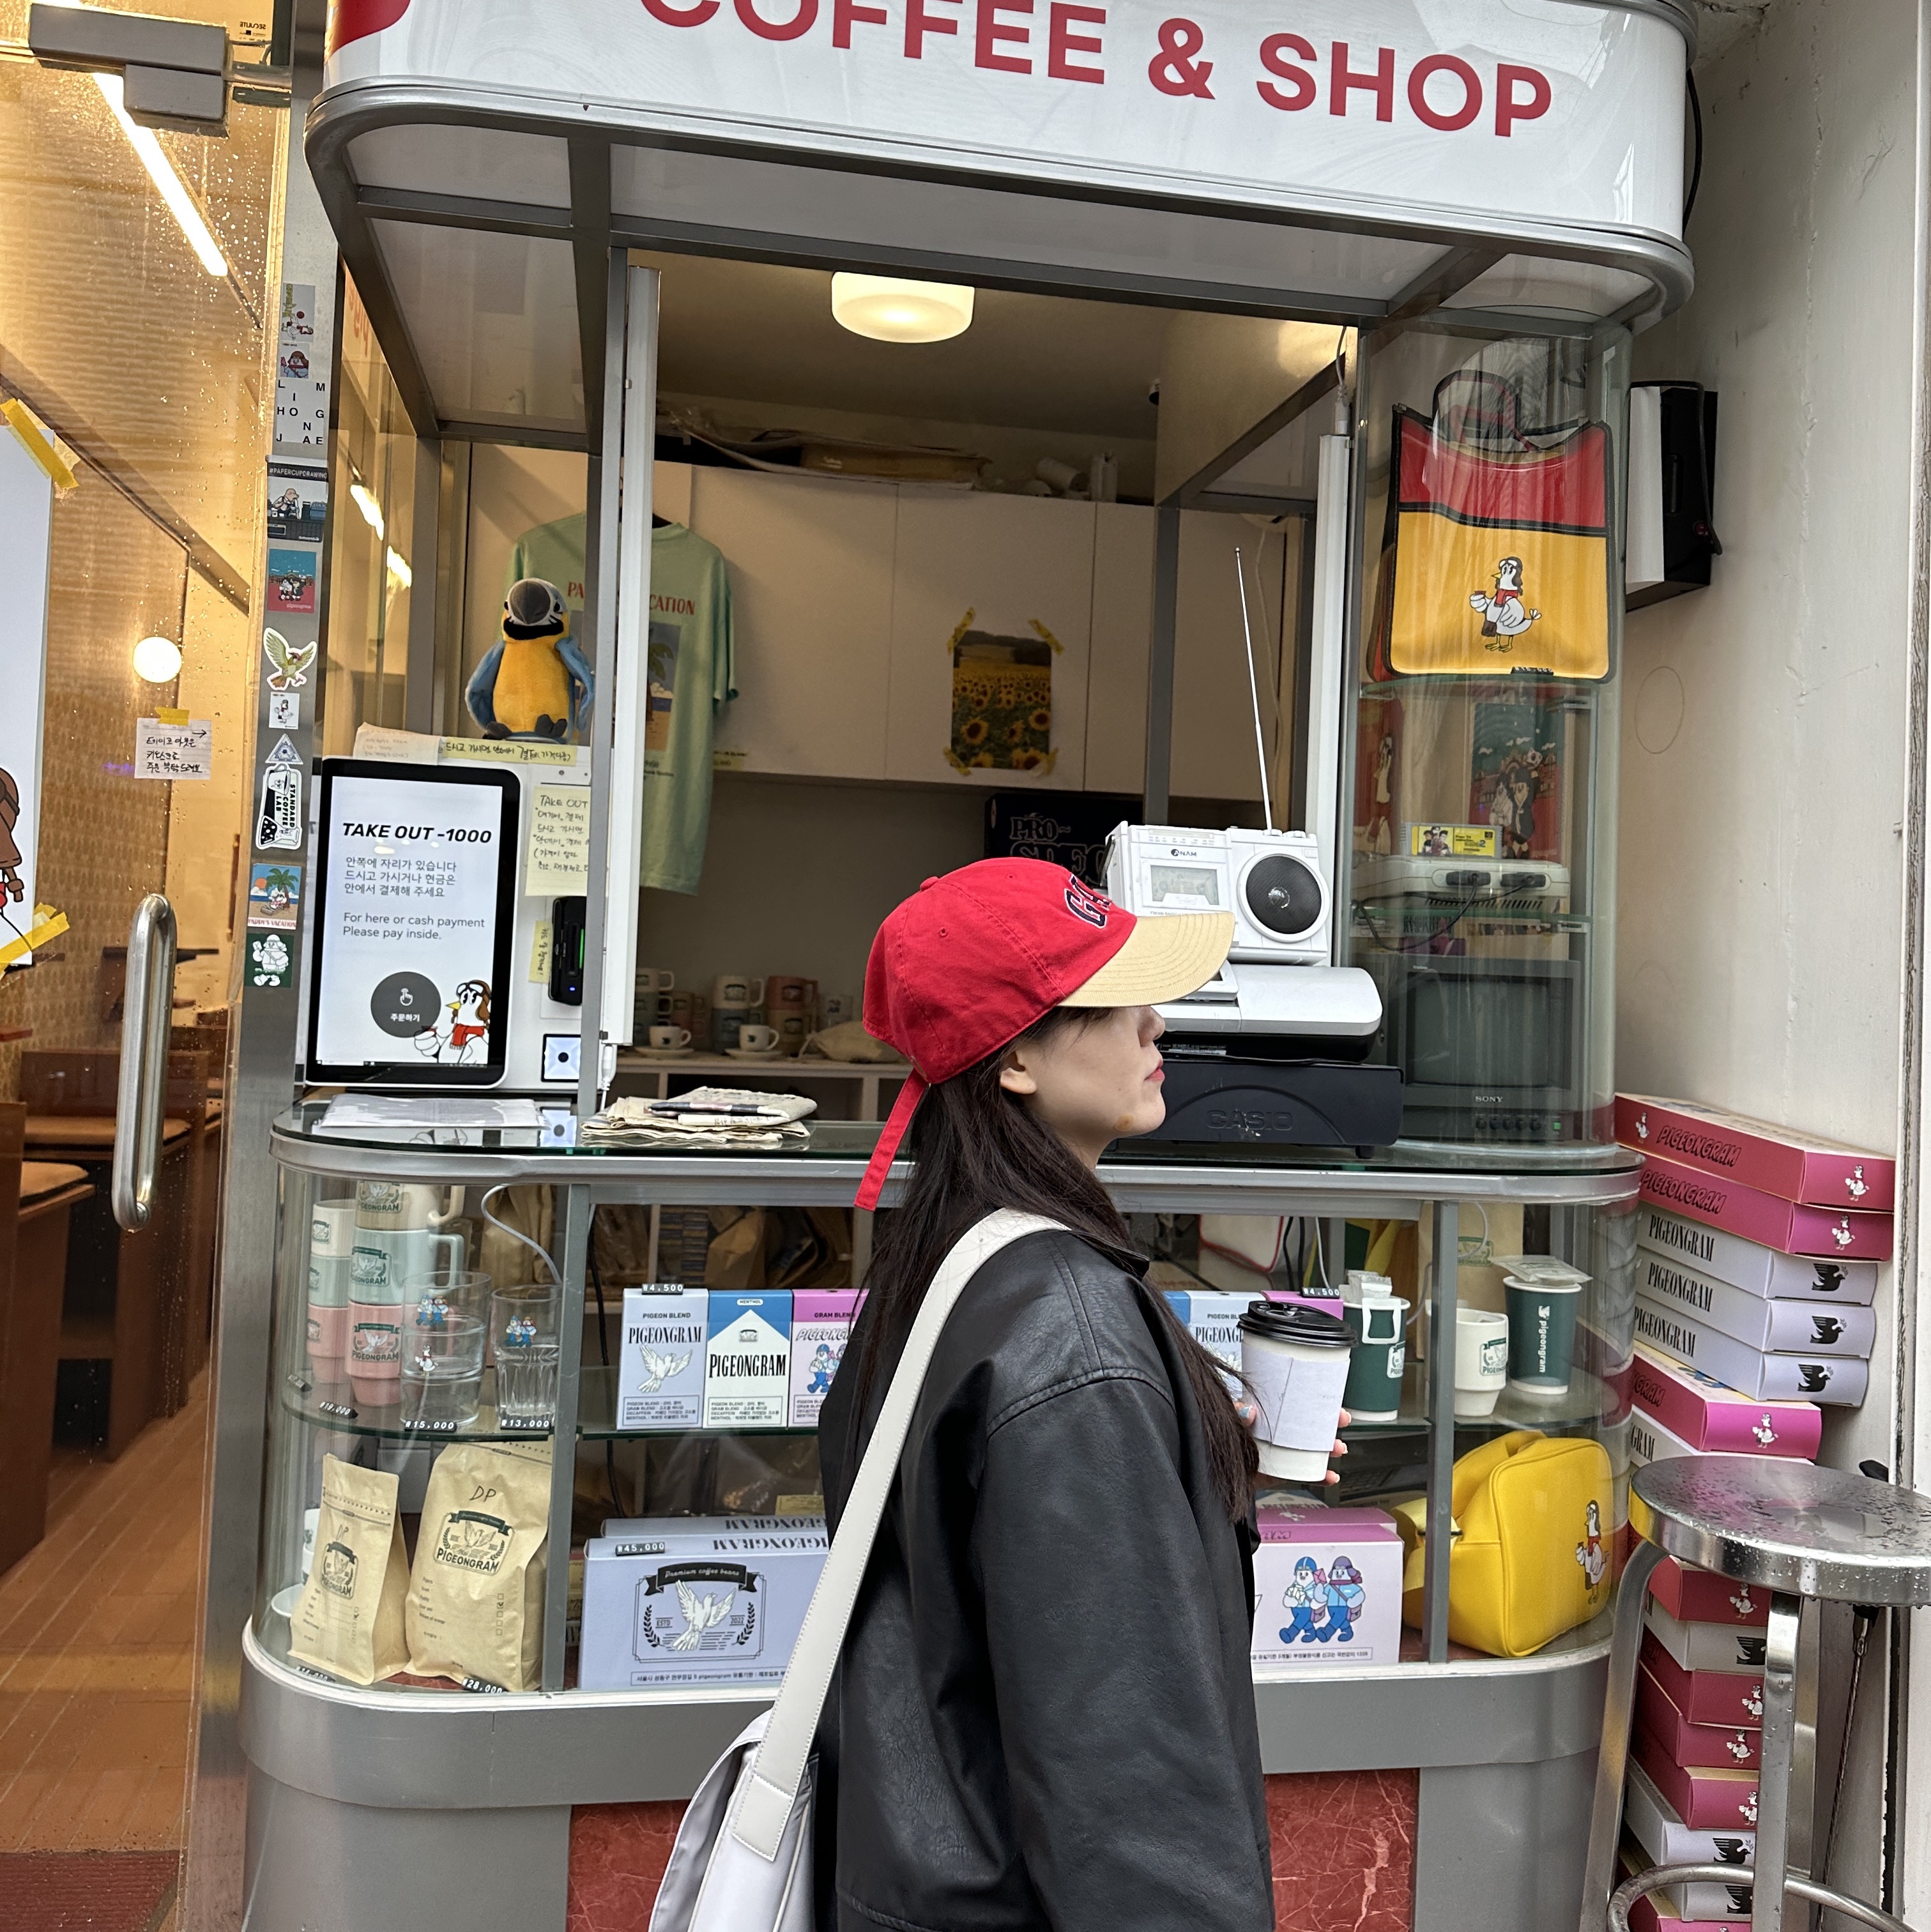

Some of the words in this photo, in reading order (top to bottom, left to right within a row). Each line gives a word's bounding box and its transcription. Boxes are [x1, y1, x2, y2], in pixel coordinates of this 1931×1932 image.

[1149, 19, 1213, 98] &
[1258, 34, 1551, 136] SHOP
[540, 795, 563, 807] TAKE
[567, 799, 588, 809] OUT
[343, 823, 391, 838] TAKE
[395, 826, 435, 840] OUT
[438, 829, 492, 843] -1000
[346, 856, 377, 868] 안쪽에
[381, 858, 412, 870] 자리가
[416, 860, 457, 872] 있습니다
[345, 871, 376, 881] 드시고
[380, 872, 422, 883] 가시거나
[425, 874, 456, 885] 현금은
[344, 883, 376, 894] 안에서
[379, 885, 410, 896] 결제해
[414, 886, 445, 897] 주세요
[344, 912, 362, 922] For
[365, 913, 390, 924] here
[393, 916, 405, 924] or
[408, 915, 434, 925] cash
[438, 918, 485, 929] payment
[343, 926, 379, 937] Please
[383, 929, 403, 940] pay
[406, 929, 442, 939] inside.
[390, 1013, 420, 1022] 주문하기
[1207, 1110, 1293, 1130] CASIO
[1656, 1125, 1742, 1168] PIGEONGRAM
[1640, 1169, 1727, 1214] PIGEONGRAM
[1649, 1214, 1714, 1262] PIGEONGRAM
[1647, 1262, 1713, 1312] PIGEONGRAM
[629, 1326, 701, 1344] PIGEONGRAM
[1538, 1320, 1550, 1373] pigeongram
[709, 1354, 786, 1378] PIGEONGRAM
[469, 1485, 497, 1502] DP
[436, 1547, 500, 1572] PIGEONGRAM
[665, 1569, 696, 1578] Premium
[698, 1567, 719, 1576] coffee
[720, 1567, 740, 1576] beans
